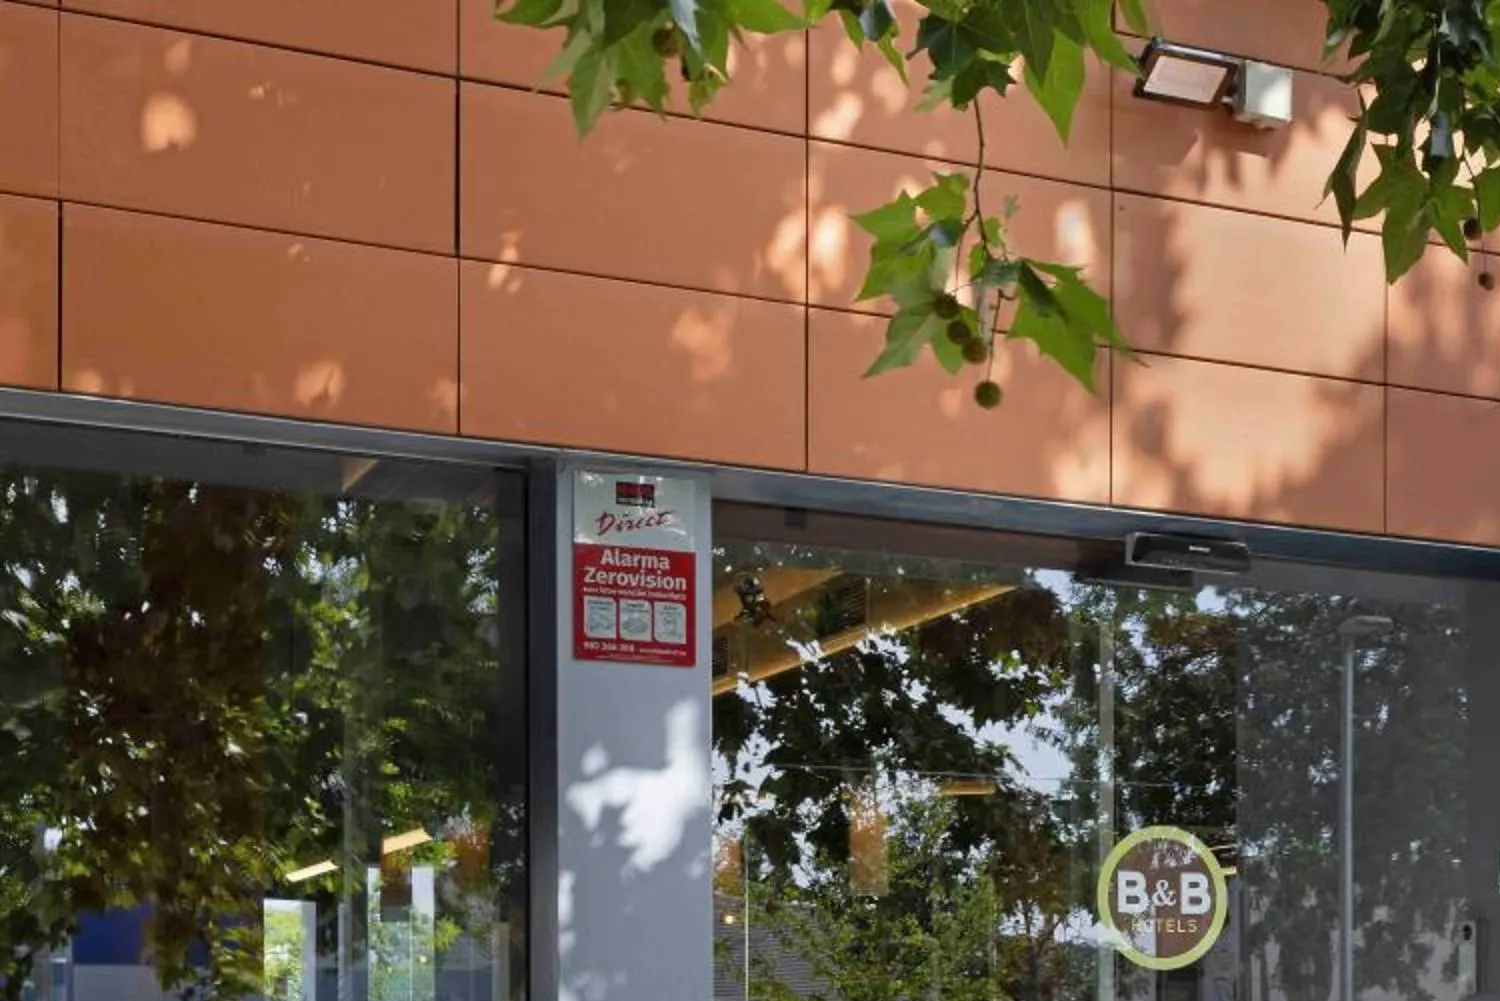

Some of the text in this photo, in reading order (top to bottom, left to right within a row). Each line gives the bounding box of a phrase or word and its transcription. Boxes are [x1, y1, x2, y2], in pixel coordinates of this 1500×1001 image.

[601, 548, 670, 570] Alarma
[583, 566, 687, 590] Zerovision
[1117, 870, 1211, 915] B&B
